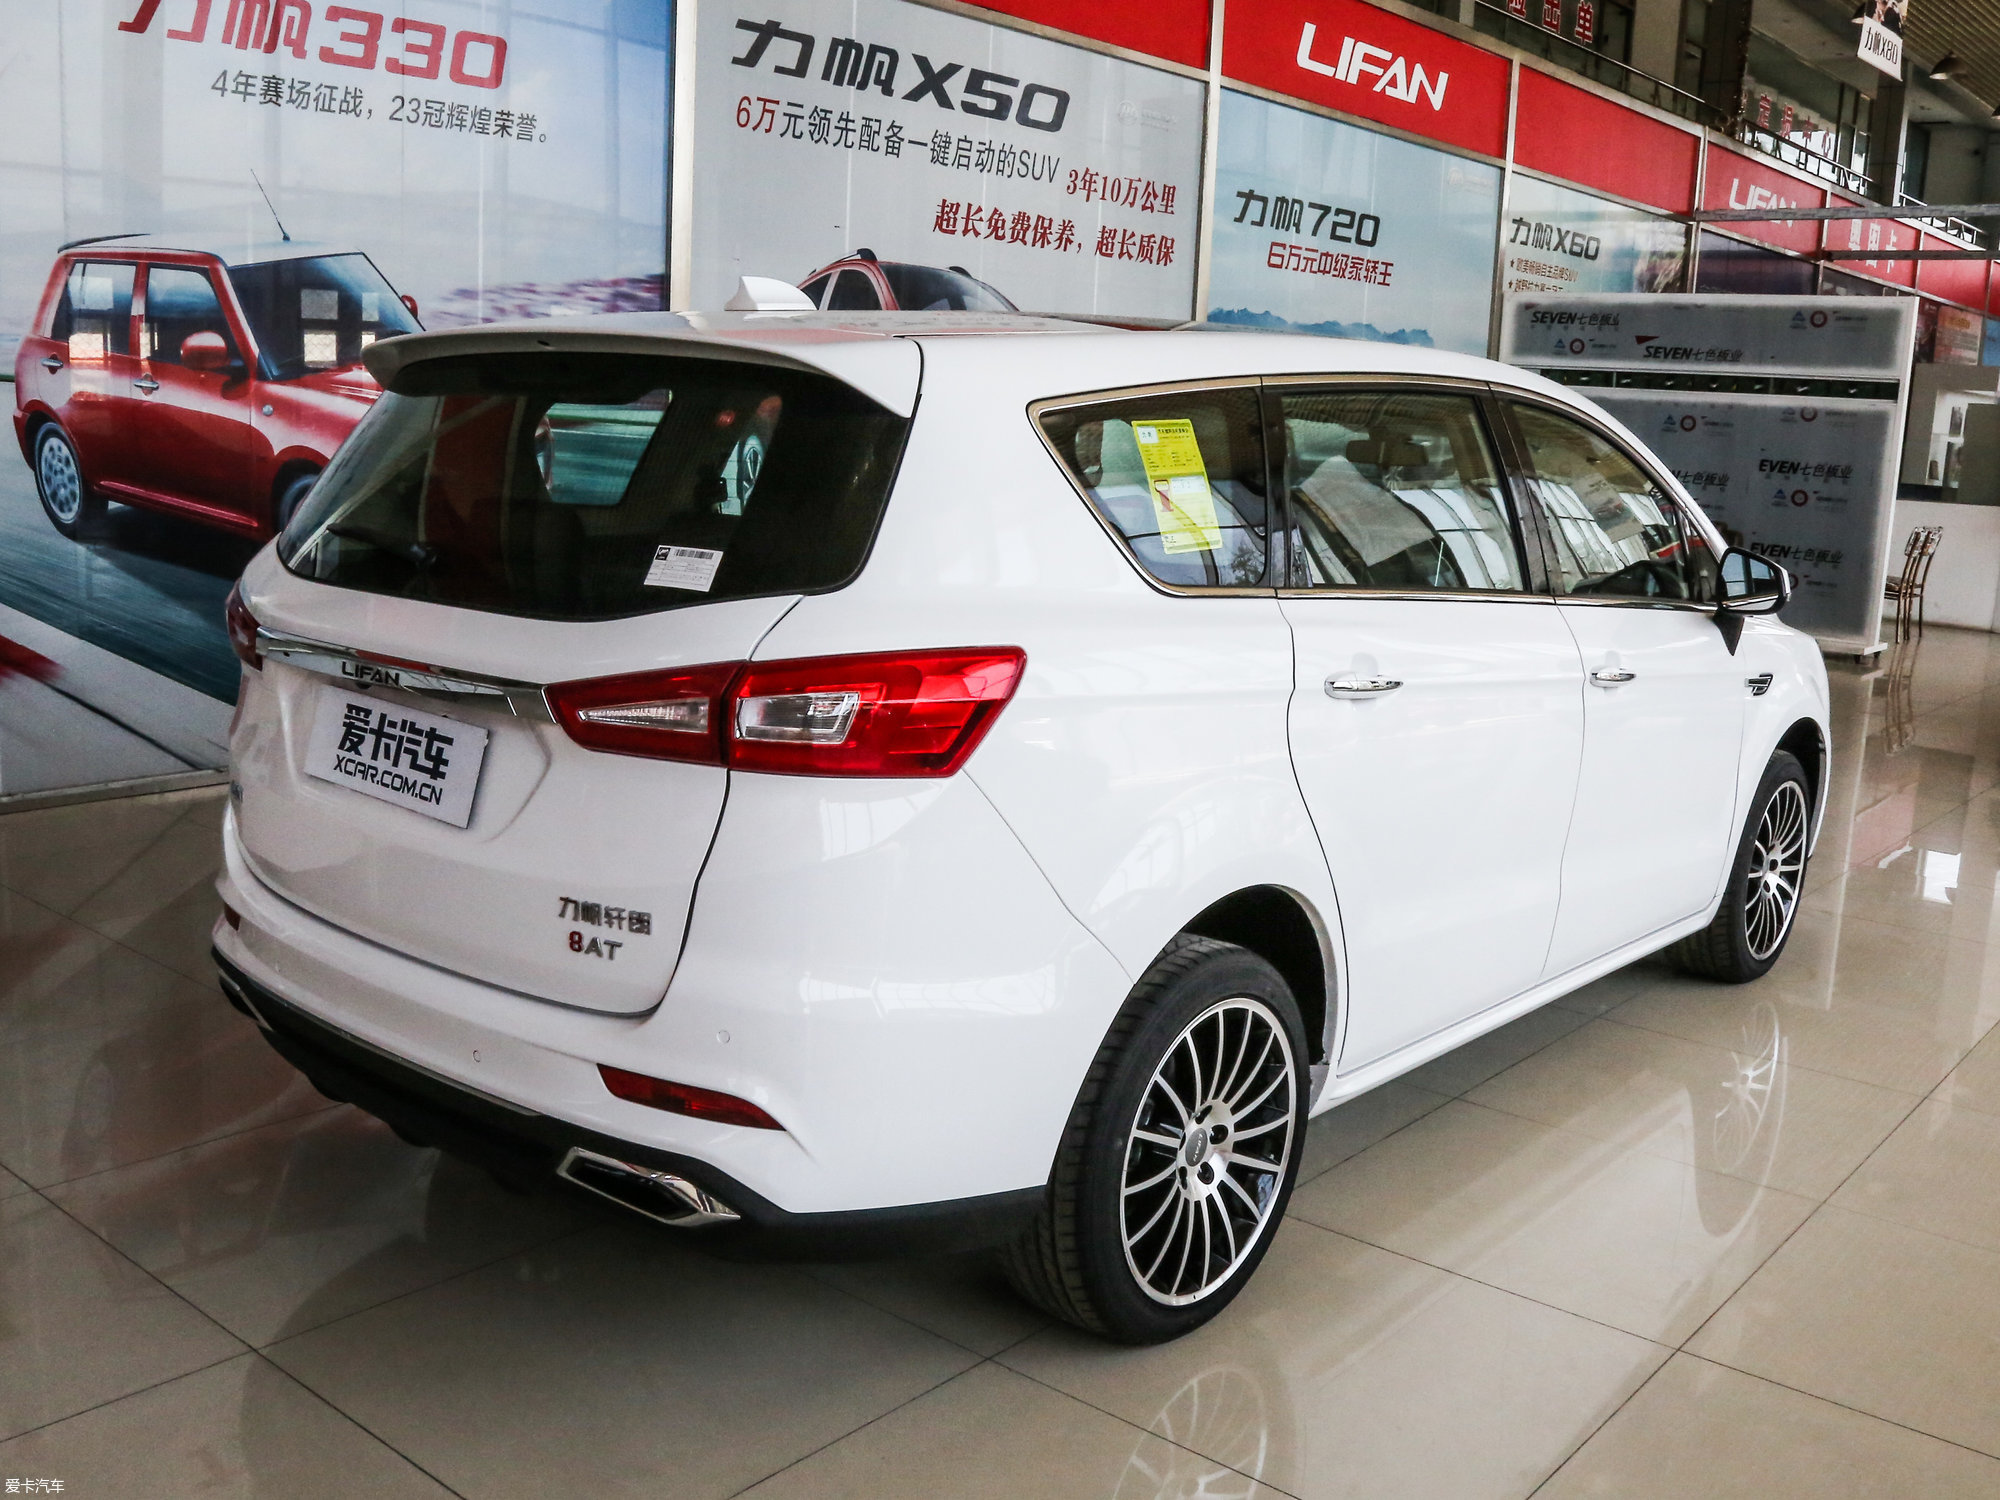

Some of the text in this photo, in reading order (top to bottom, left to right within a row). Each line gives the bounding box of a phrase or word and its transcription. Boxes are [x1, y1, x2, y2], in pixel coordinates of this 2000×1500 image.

[731, 19, 1071, 132] 力帆X50
[1297, 22, 1449, 111] LIFAN
[736, 95, 1060, 184] 6万元领先配备一键启动的SUV
[1066, 167, 1177, 215] 3年10万公里
[1233, 189, 1381, 248] 力帆720
[932, 198, 1176, 267] 超长免费保养，超长质保
[1509, 217, 1601, 260] 力帆X60
[1267, 241, 1395, 287] 6万元中级家轿王
[341, 661, 400, 686] LIFAN
[338, 703, 454, 780] 爱卡汽车
[334, 754, 443, 805] XCAR.COM.CN
[568, 931, 624, 961] 8AT
